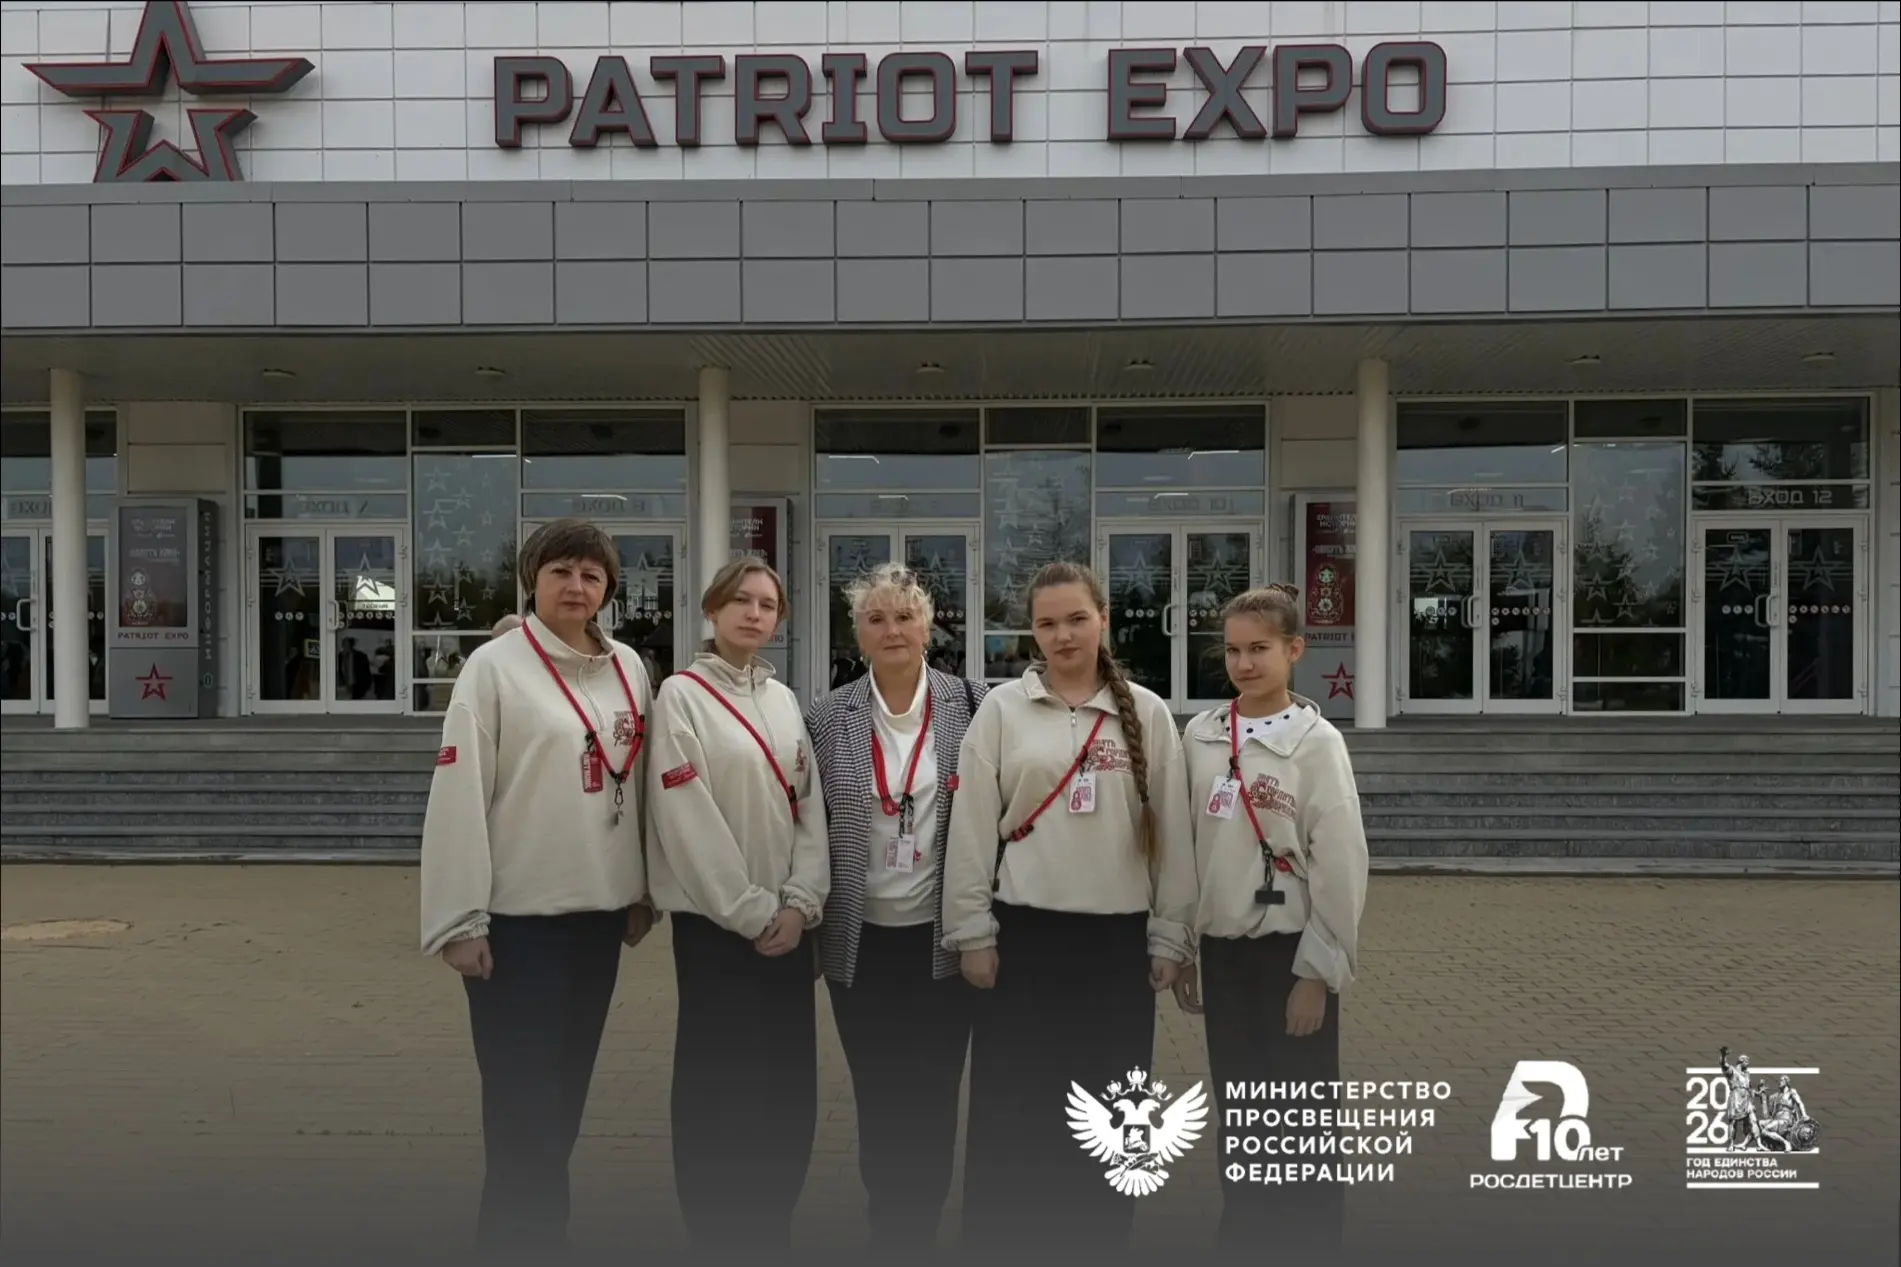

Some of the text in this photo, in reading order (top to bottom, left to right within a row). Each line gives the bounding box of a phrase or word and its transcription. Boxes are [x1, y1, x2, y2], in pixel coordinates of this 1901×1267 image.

[494, 41, 1447, 148] PATRIOT EXPO
[1747, 489, 1833, 505] ВХОД 12
[117, 632, 189, 640] PATRIOT EXPO
